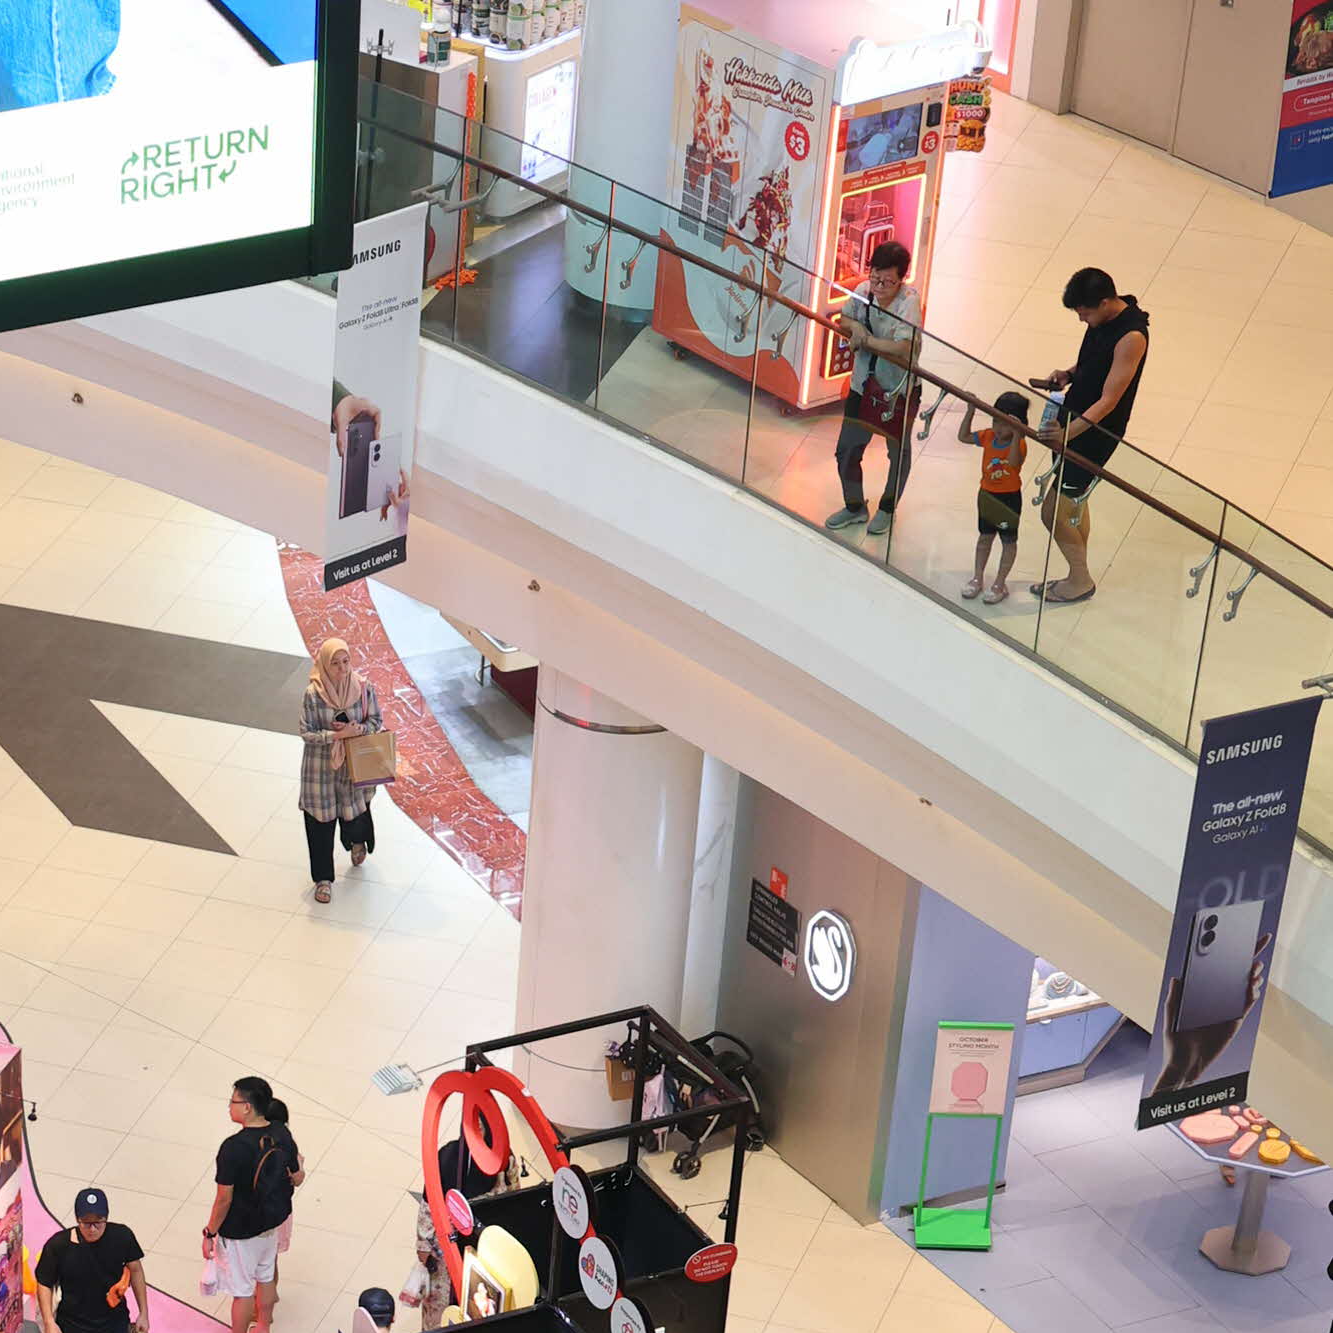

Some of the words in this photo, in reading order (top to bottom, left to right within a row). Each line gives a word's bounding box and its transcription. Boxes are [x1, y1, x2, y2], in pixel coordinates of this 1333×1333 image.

[724, 57, 782, 95] Hokkaido
[781, 78, 814, 107] Milk
[950, 80, 985, 95] HUNT
[948, 92, 983, 106] CASH
[955, 108, 984, 120] $1000
[142, 124, 270, 172] RETURN
[789, 135, 806, 158] $3
[923, 136, 936, 151] $3
[119, 163, 219, 205] RIGHT
[352, 239, 402, 265] AMSUNG
[332, 567, 351, 581] Visit
[350, 564, 361, 574] us
[361, 559, 371, 571] at
[371, 551, 392, 567] Level
[392, 548, 398, 559] 2
[1205, 734, 1284, 765] SAMSUNG
[1211, 801, 1235, 816] The
[1235, 789, 1284, 812] all-new
[1201, 812, 1245, 833] Galaxy
[1244, 810, 1253, 822] Z
[1253, 802, 1287, 821] Fold8
[1211, 828, 1247, 844] Galaxy
[1247, 825, 1259, 835] AI
[1150, 1104, 1172, 1119] Visit
[1173, 1100, 1187, 1113] us
[1187, 1097, 1200, 1109] at
[1201, 1088, 1229, 1105] Level
[1229, 1086, 1236, 1098] 2
[594, 1274, 614, 1296] hearts
[595, 1263, 615, 1288] SHAPING
